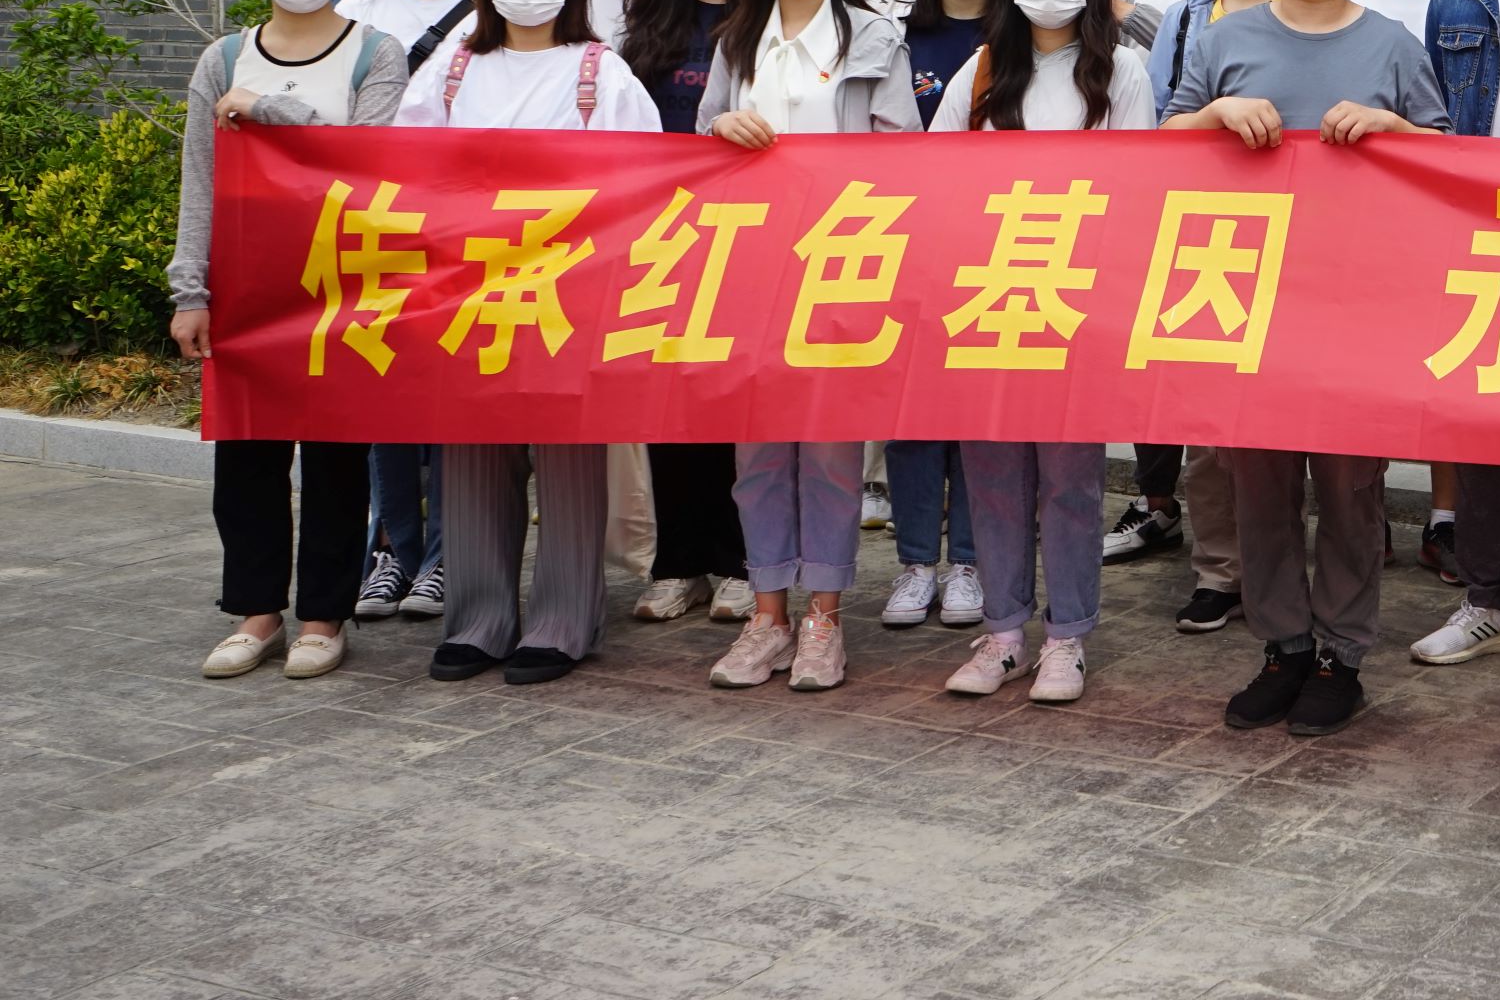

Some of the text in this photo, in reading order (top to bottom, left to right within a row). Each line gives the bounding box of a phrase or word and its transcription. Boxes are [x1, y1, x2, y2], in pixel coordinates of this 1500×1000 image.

[299, 179, 1295, 376] 传承红色基因
